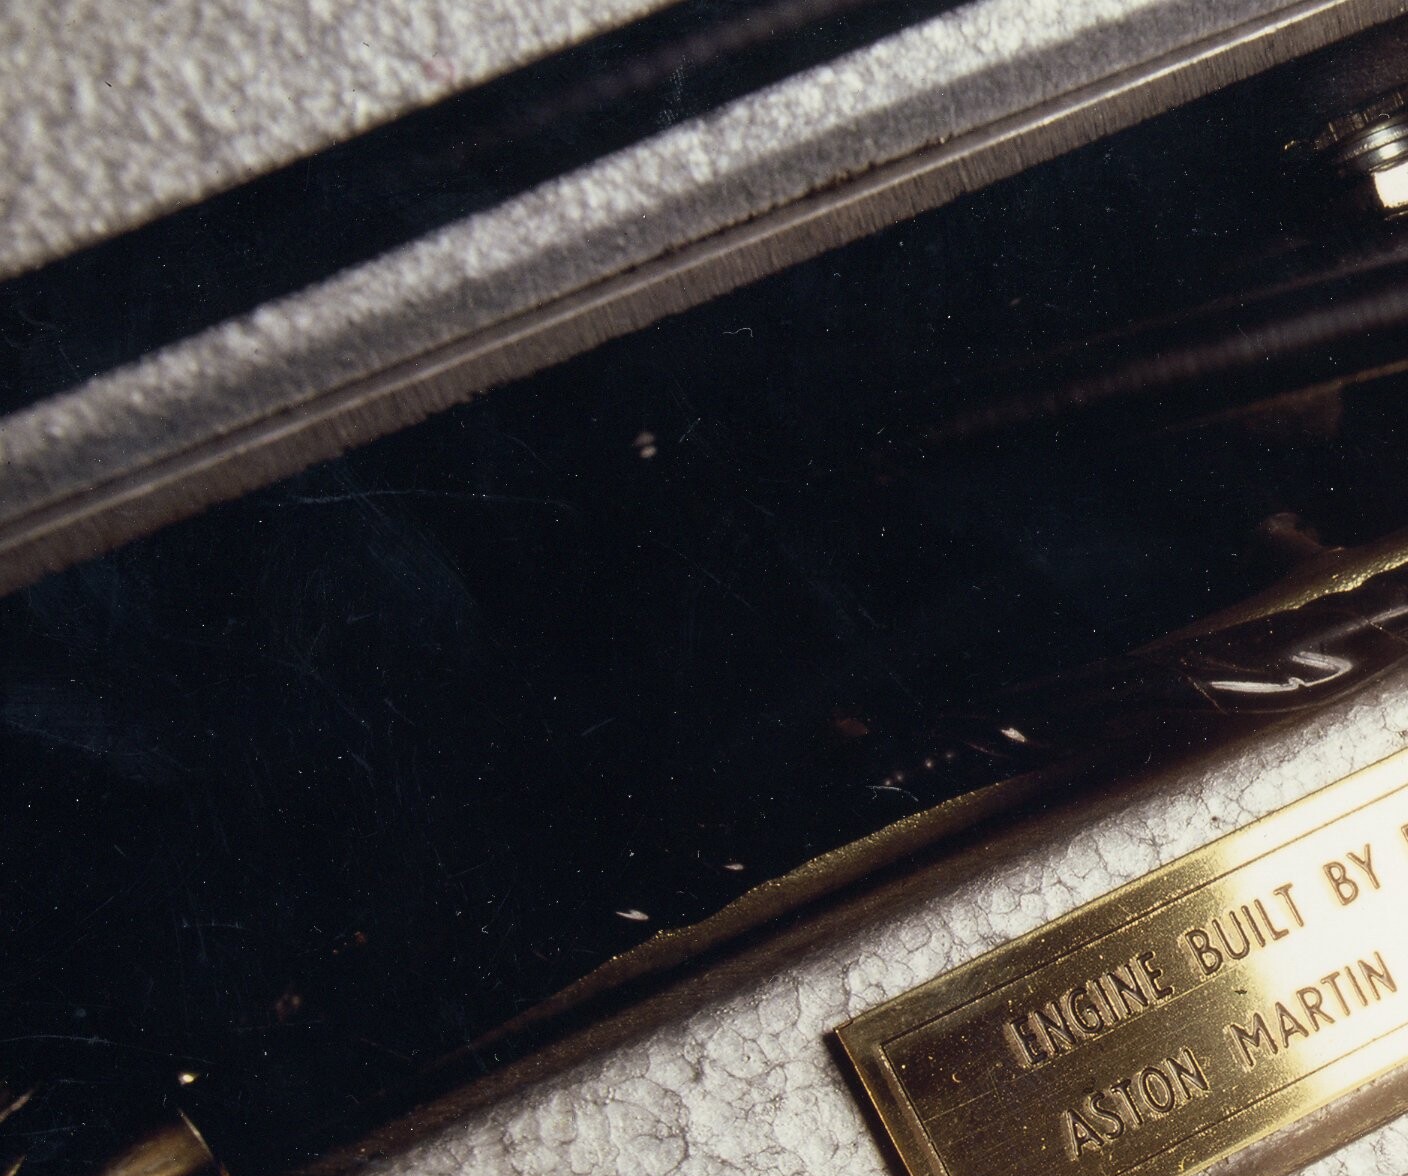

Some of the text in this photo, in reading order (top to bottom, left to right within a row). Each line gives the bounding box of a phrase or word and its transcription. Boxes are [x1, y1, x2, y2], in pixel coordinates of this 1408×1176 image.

[1006, 950, 1174, 1067] ENGINE
[1181, 882, 1305, 978] BUILT
[1322, 843, 1382, 907] BY
[1062, 1047, 1210, 1160] ASTON
[1228, 951, 1398, 1070] MARTIN
